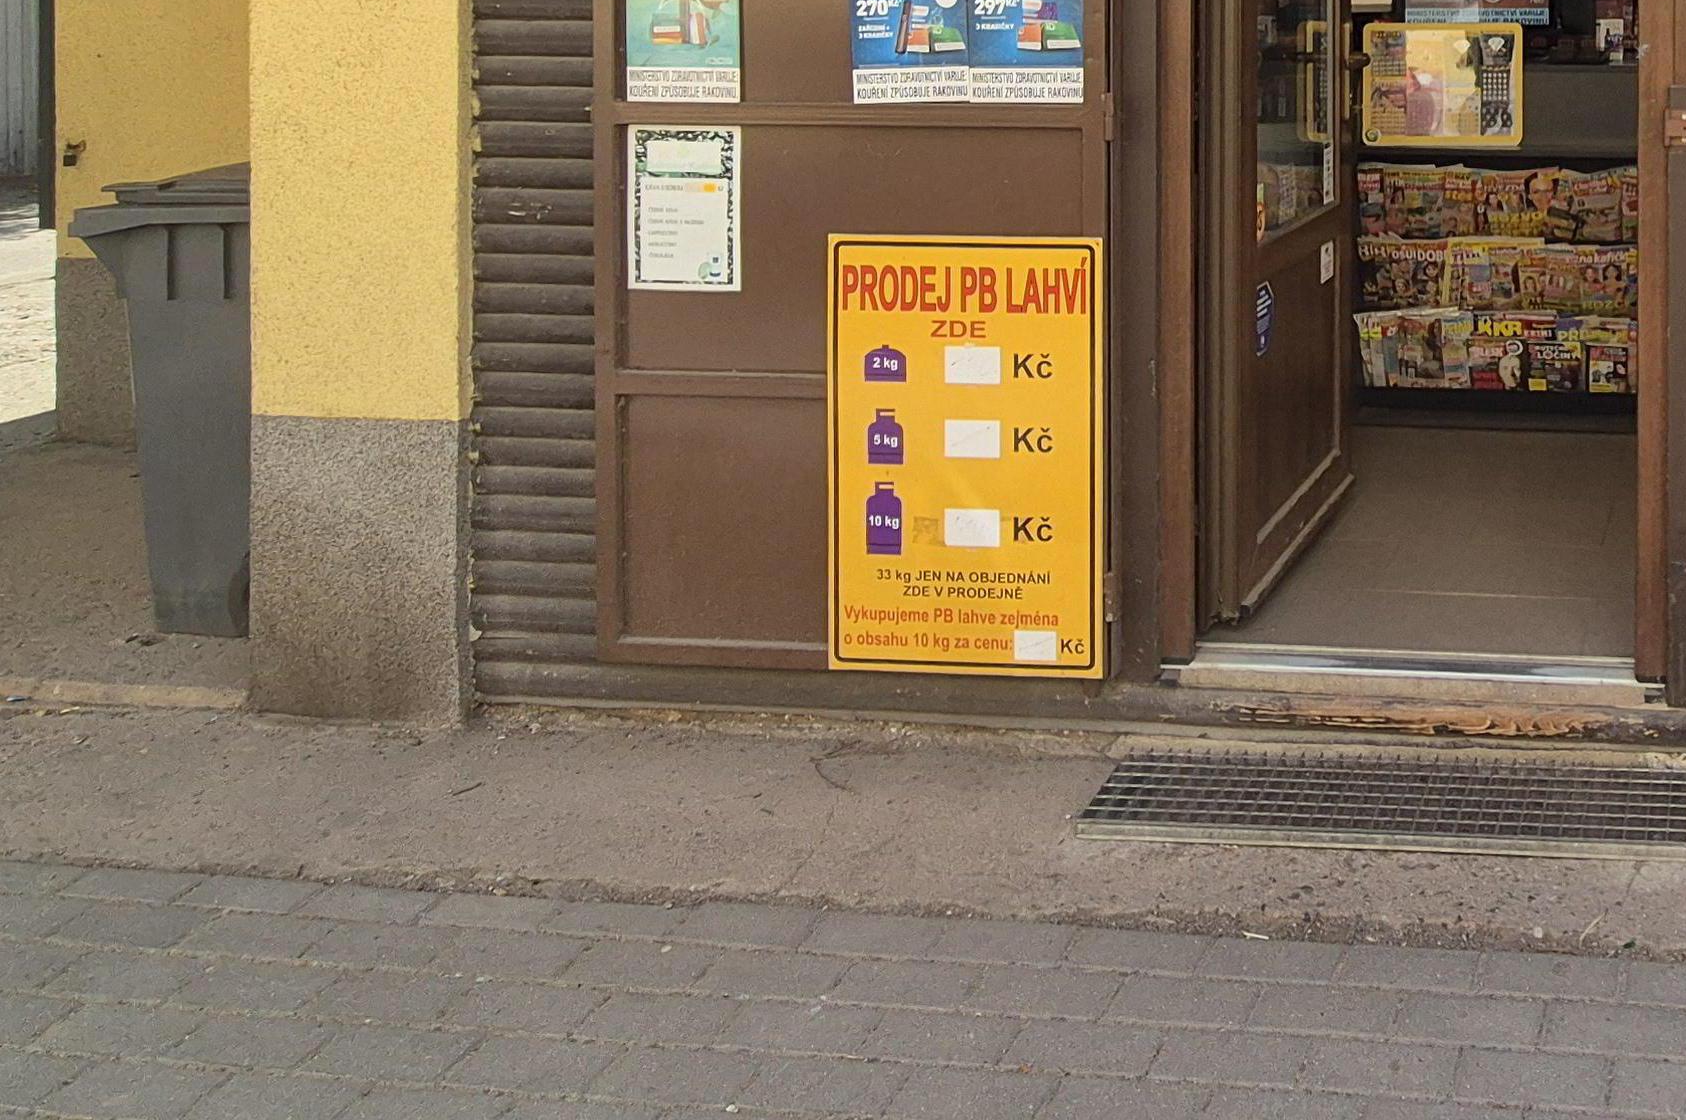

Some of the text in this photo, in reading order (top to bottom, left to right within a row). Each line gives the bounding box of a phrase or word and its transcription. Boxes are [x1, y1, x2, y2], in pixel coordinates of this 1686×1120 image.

[842, 256, 1088, 315] PRODEJ PB LAHVÍ
[930, 319, 987, 339] ZDE
[872, 356, 899, 372] 2 kg
[1012, 353, 1054, 380] Kč
[873, 433, 899, 449] 5 kg
[1012, 426, 1054, 454] Kč
[868, 515, 900, 530] 10 kg
[1012, 516, 1054, 543] Kč
[877, 569, 1051, 585] 33 kg JEN NA OBJEDNÁNÍ
[903, 586, 930, 597] ZDE
[934, 586, 943, 597] V
[843, 605, 1059, 629] Vykupujeme PB lahve zejména
[844, 631, 1085, 655] o obsahu 10 kg za cenu: Kč
